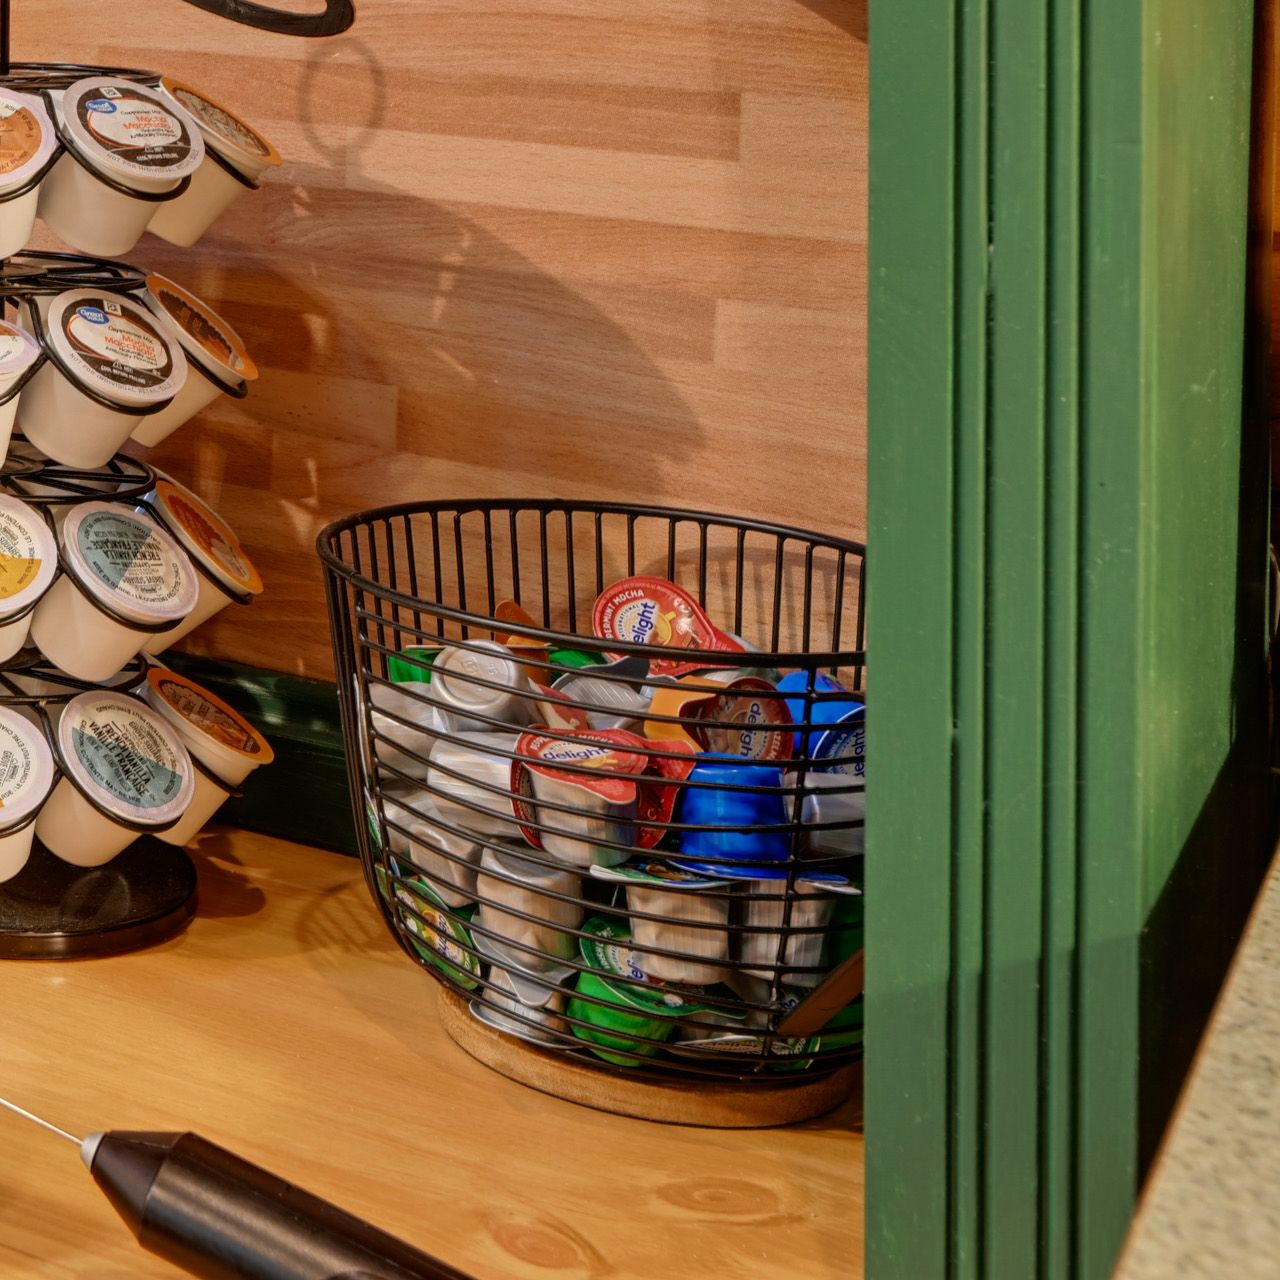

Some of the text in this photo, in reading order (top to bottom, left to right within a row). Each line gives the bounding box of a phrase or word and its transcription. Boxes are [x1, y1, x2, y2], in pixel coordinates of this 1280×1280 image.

[122, 122, 171, 130] Macchiato
[104, 335, 157, 358] Macchiato
[122, 334, 155, 352] Mocha
[0, 536, 20, 558] SQUARE
[103, 550, 133, 561] VANILLA
[602, 589, 645, 639] PERMINT MOCHA
[633, 602, 657, 644] elight
[89, 721, 117, 753] VANILLE
[102, 723, 152, 785] FRENCH VANILLA
[543, 746, 614, 761] delight
[81, 750, 104, 782] CONTENTS
[104, 780, 117, 794] MAY
